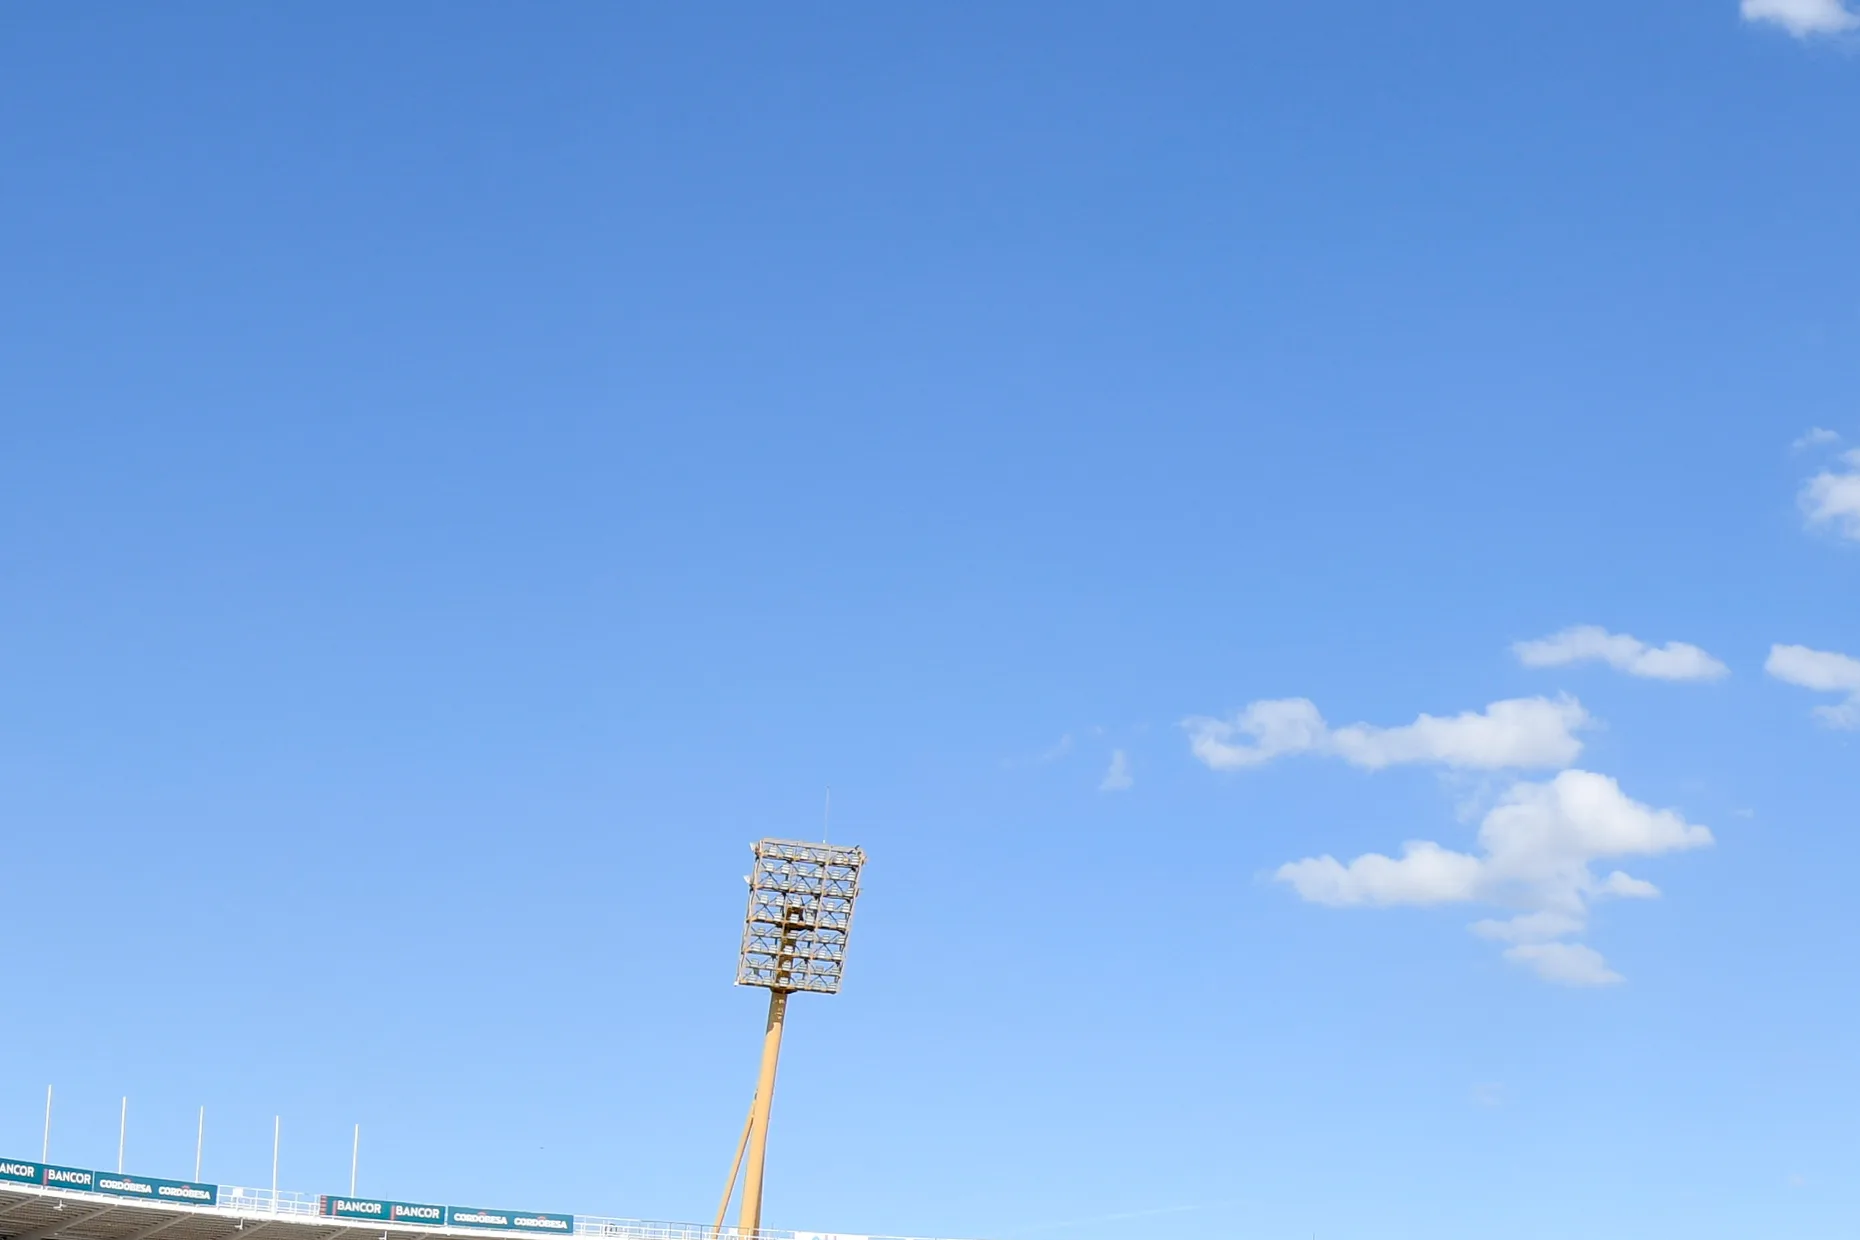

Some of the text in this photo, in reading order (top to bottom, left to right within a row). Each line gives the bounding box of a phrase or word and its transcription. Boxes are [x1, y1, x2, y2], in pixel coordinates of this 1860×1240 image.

[48, 1169, 92, 1185] BANCOR
[99, 1179, 152, 1193] CORDOBESA
[158, 1186, 211, 1200] CORDOBESA
[337, 1200, 382, 1214] BANCOR
[396, 1205, 440, 1219] BANCOR
[453, 1213, 508, 1225] CORDOBESA
[514, 1217, 568, 1229] CORDOBESA
